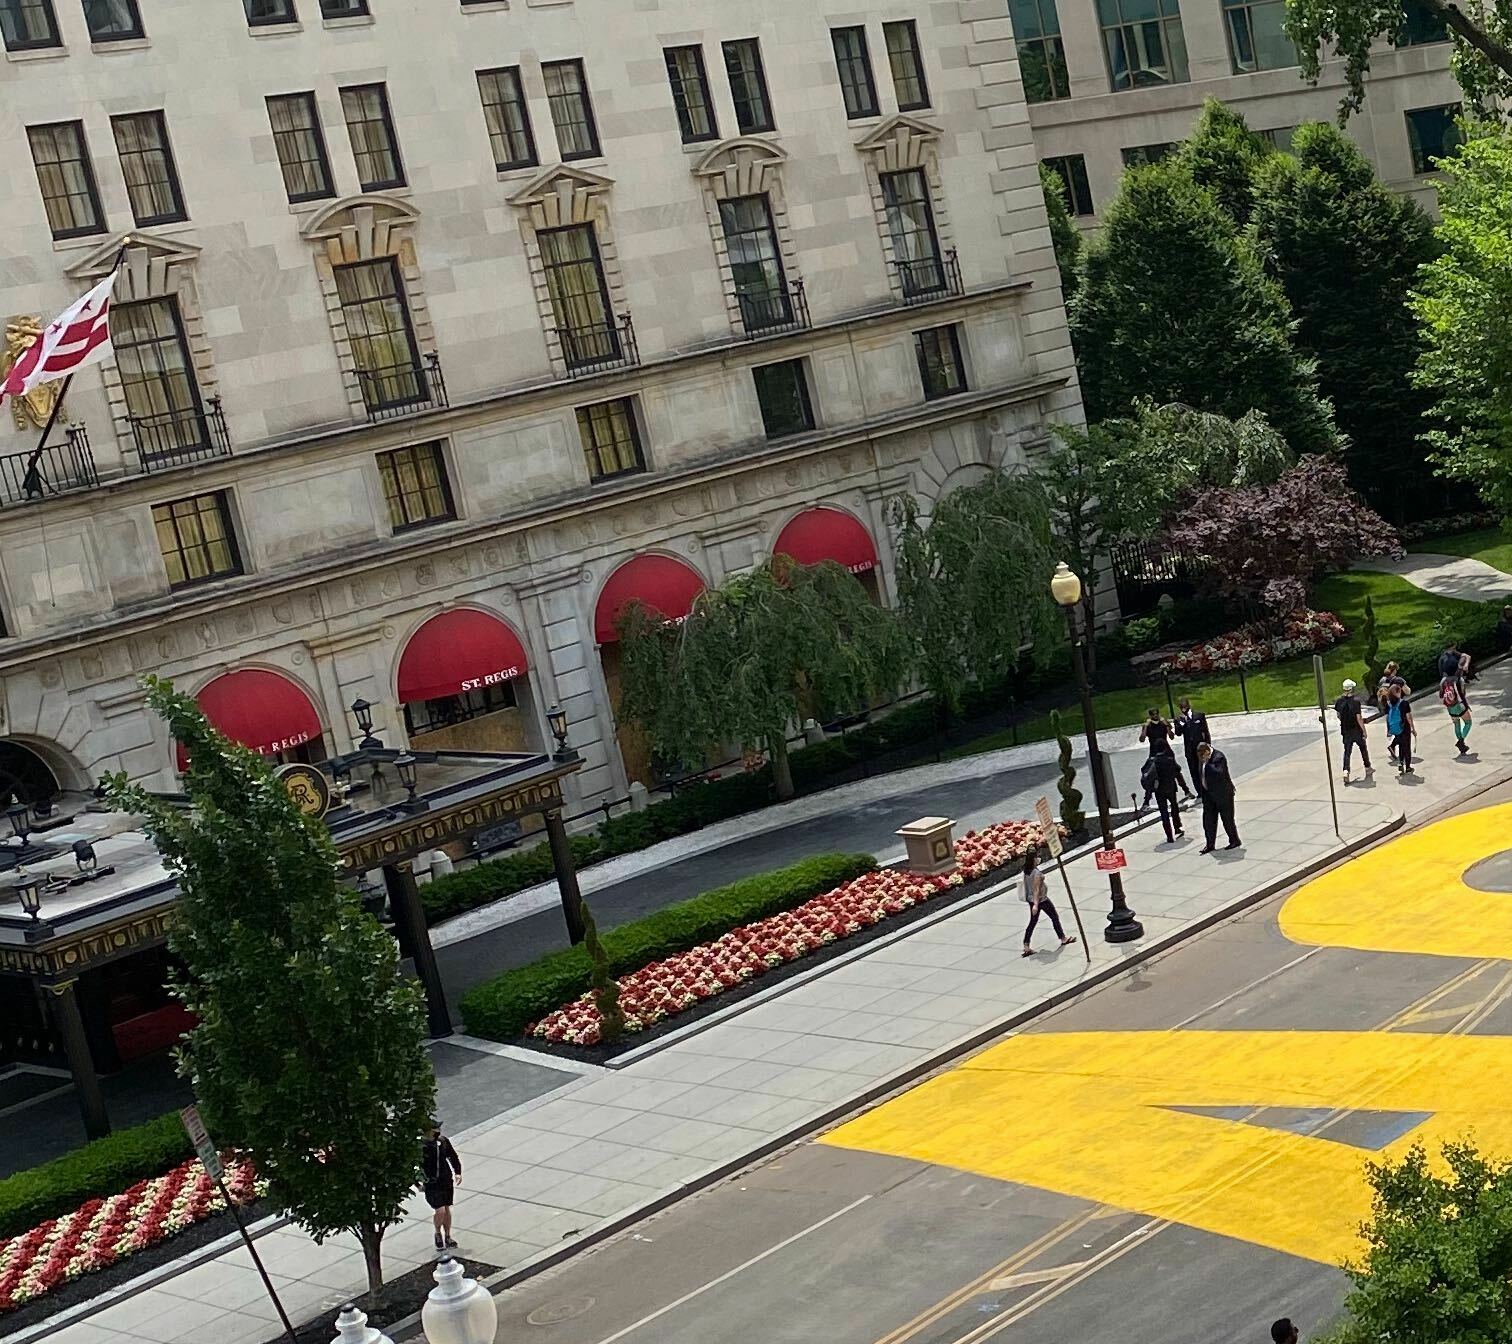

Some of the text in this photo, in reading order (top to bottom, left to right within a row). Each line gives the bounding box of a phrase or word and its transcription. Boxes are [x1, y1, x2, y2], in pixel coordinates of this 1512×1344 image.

[461, 666, 519, 691] ST. REGIS
[271, 731, 309, 752] REGIS
